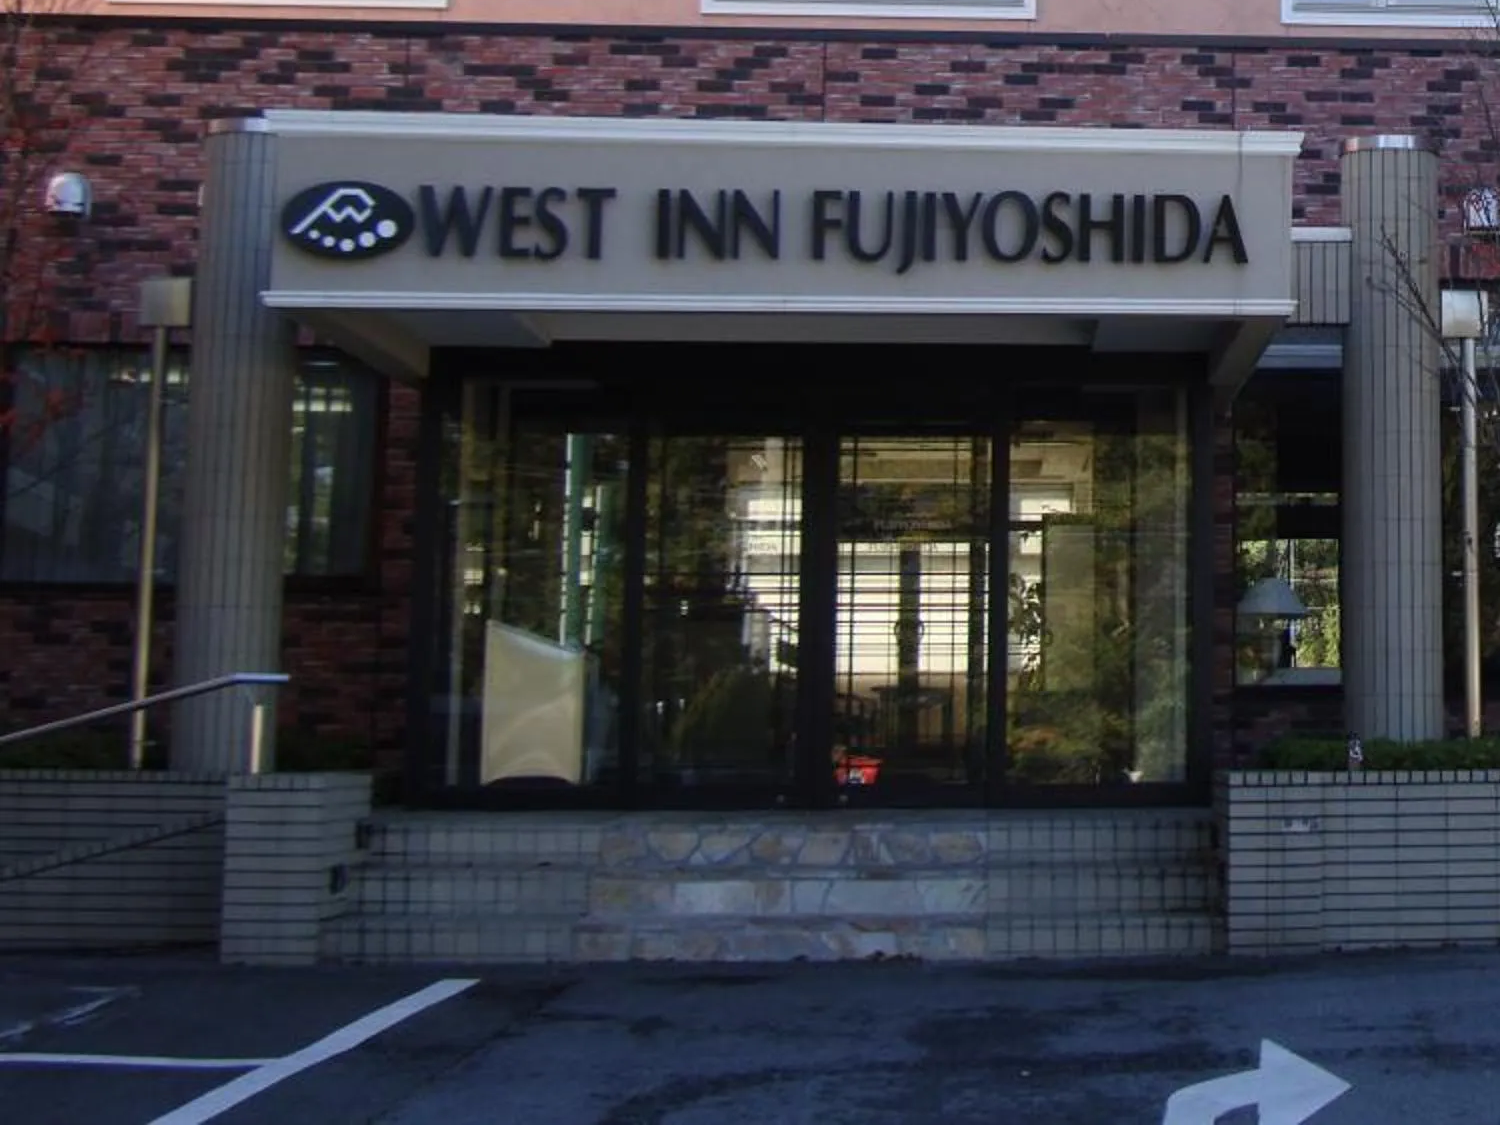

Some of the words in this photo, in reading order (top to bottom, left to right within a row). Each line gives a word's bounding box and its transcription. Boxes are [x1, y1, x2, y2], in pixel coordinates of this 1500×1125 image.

[418, 184, 617, 259] WEST
[655, 187, 781, 260] INN
[810, 189, 1249, 275] FUJIYOSHIDA
